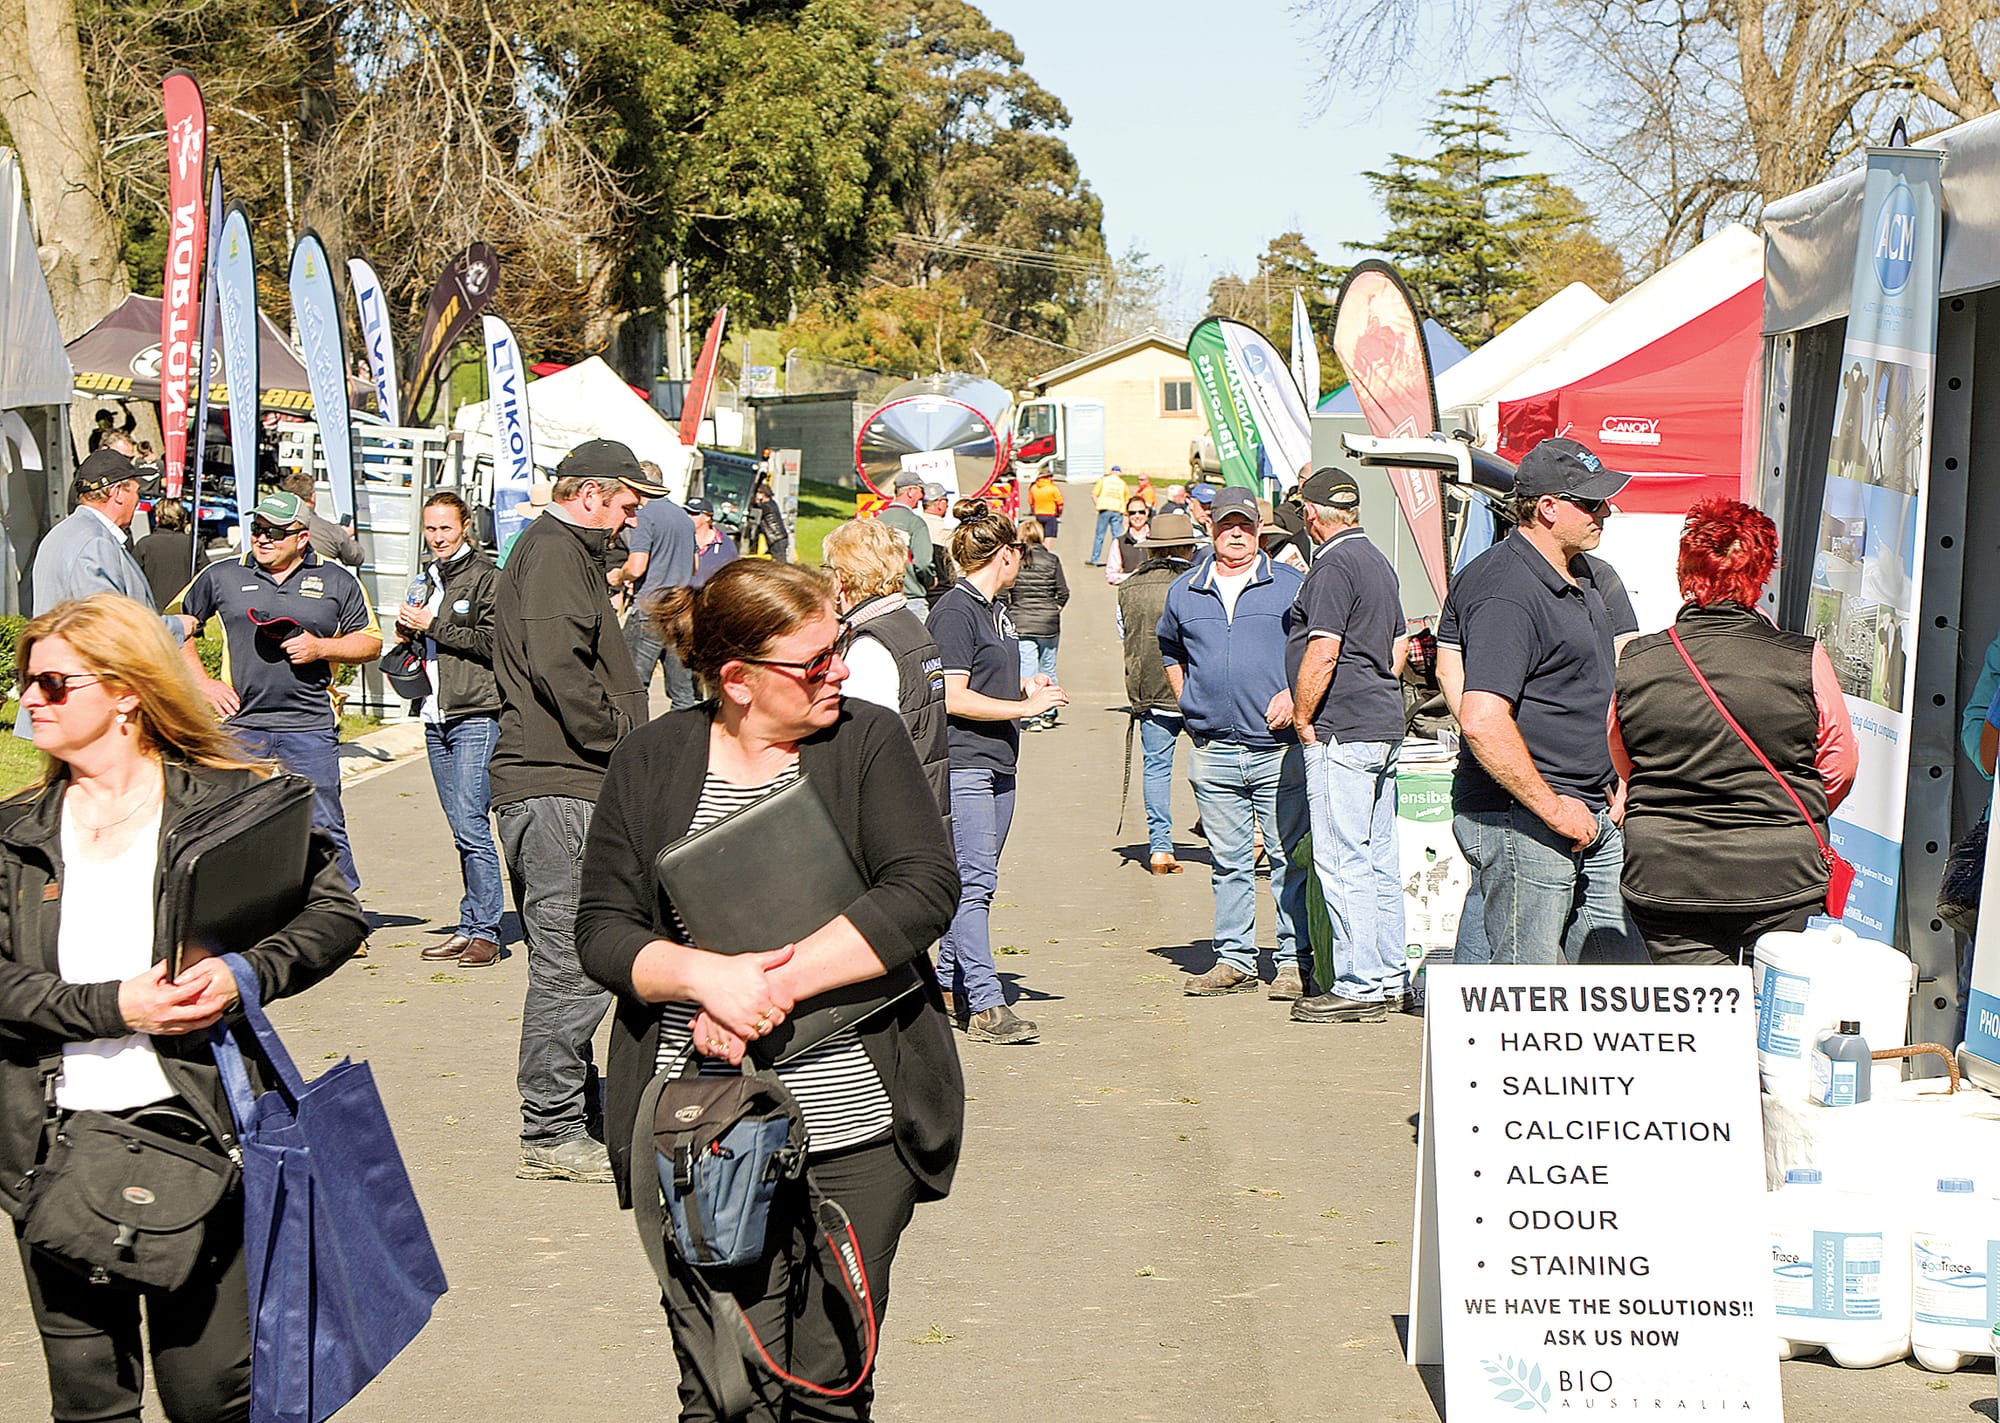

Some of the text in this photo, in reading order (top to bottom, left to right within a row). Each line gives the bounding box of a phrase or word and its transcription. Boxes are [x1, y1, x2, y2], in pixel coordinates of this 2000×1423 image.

[1875, 214, 1916, 262] ACM
[501, 376, 529, 481] VIKON
[1400, 790, 1453, 804] ensiba
[1460, 986, 1740, 1014] WATER ISSUES???
[1501, 1032, 1697, 1053] HARD WATER
[1502, 1076, 1635, 1096] SALINITY
[1504, 1120, 1731, 1142] CALCIFICATION
[1506, 1164, 1609, 1185] ALGAE
[1508, 1210, 1619, 1230] ODOUR
[1510, 1255, 1650, 1277] STAINING
[1464, 1298, 1755, 1318] WE HAVE THE SOLUTIONS!!
[1543, 1329, 1680, 1347] ASK US NOW
[1559, 1370, 1613, 1393] BIO
[1562, 1398, 1751, 1410] AUSTRALIA
